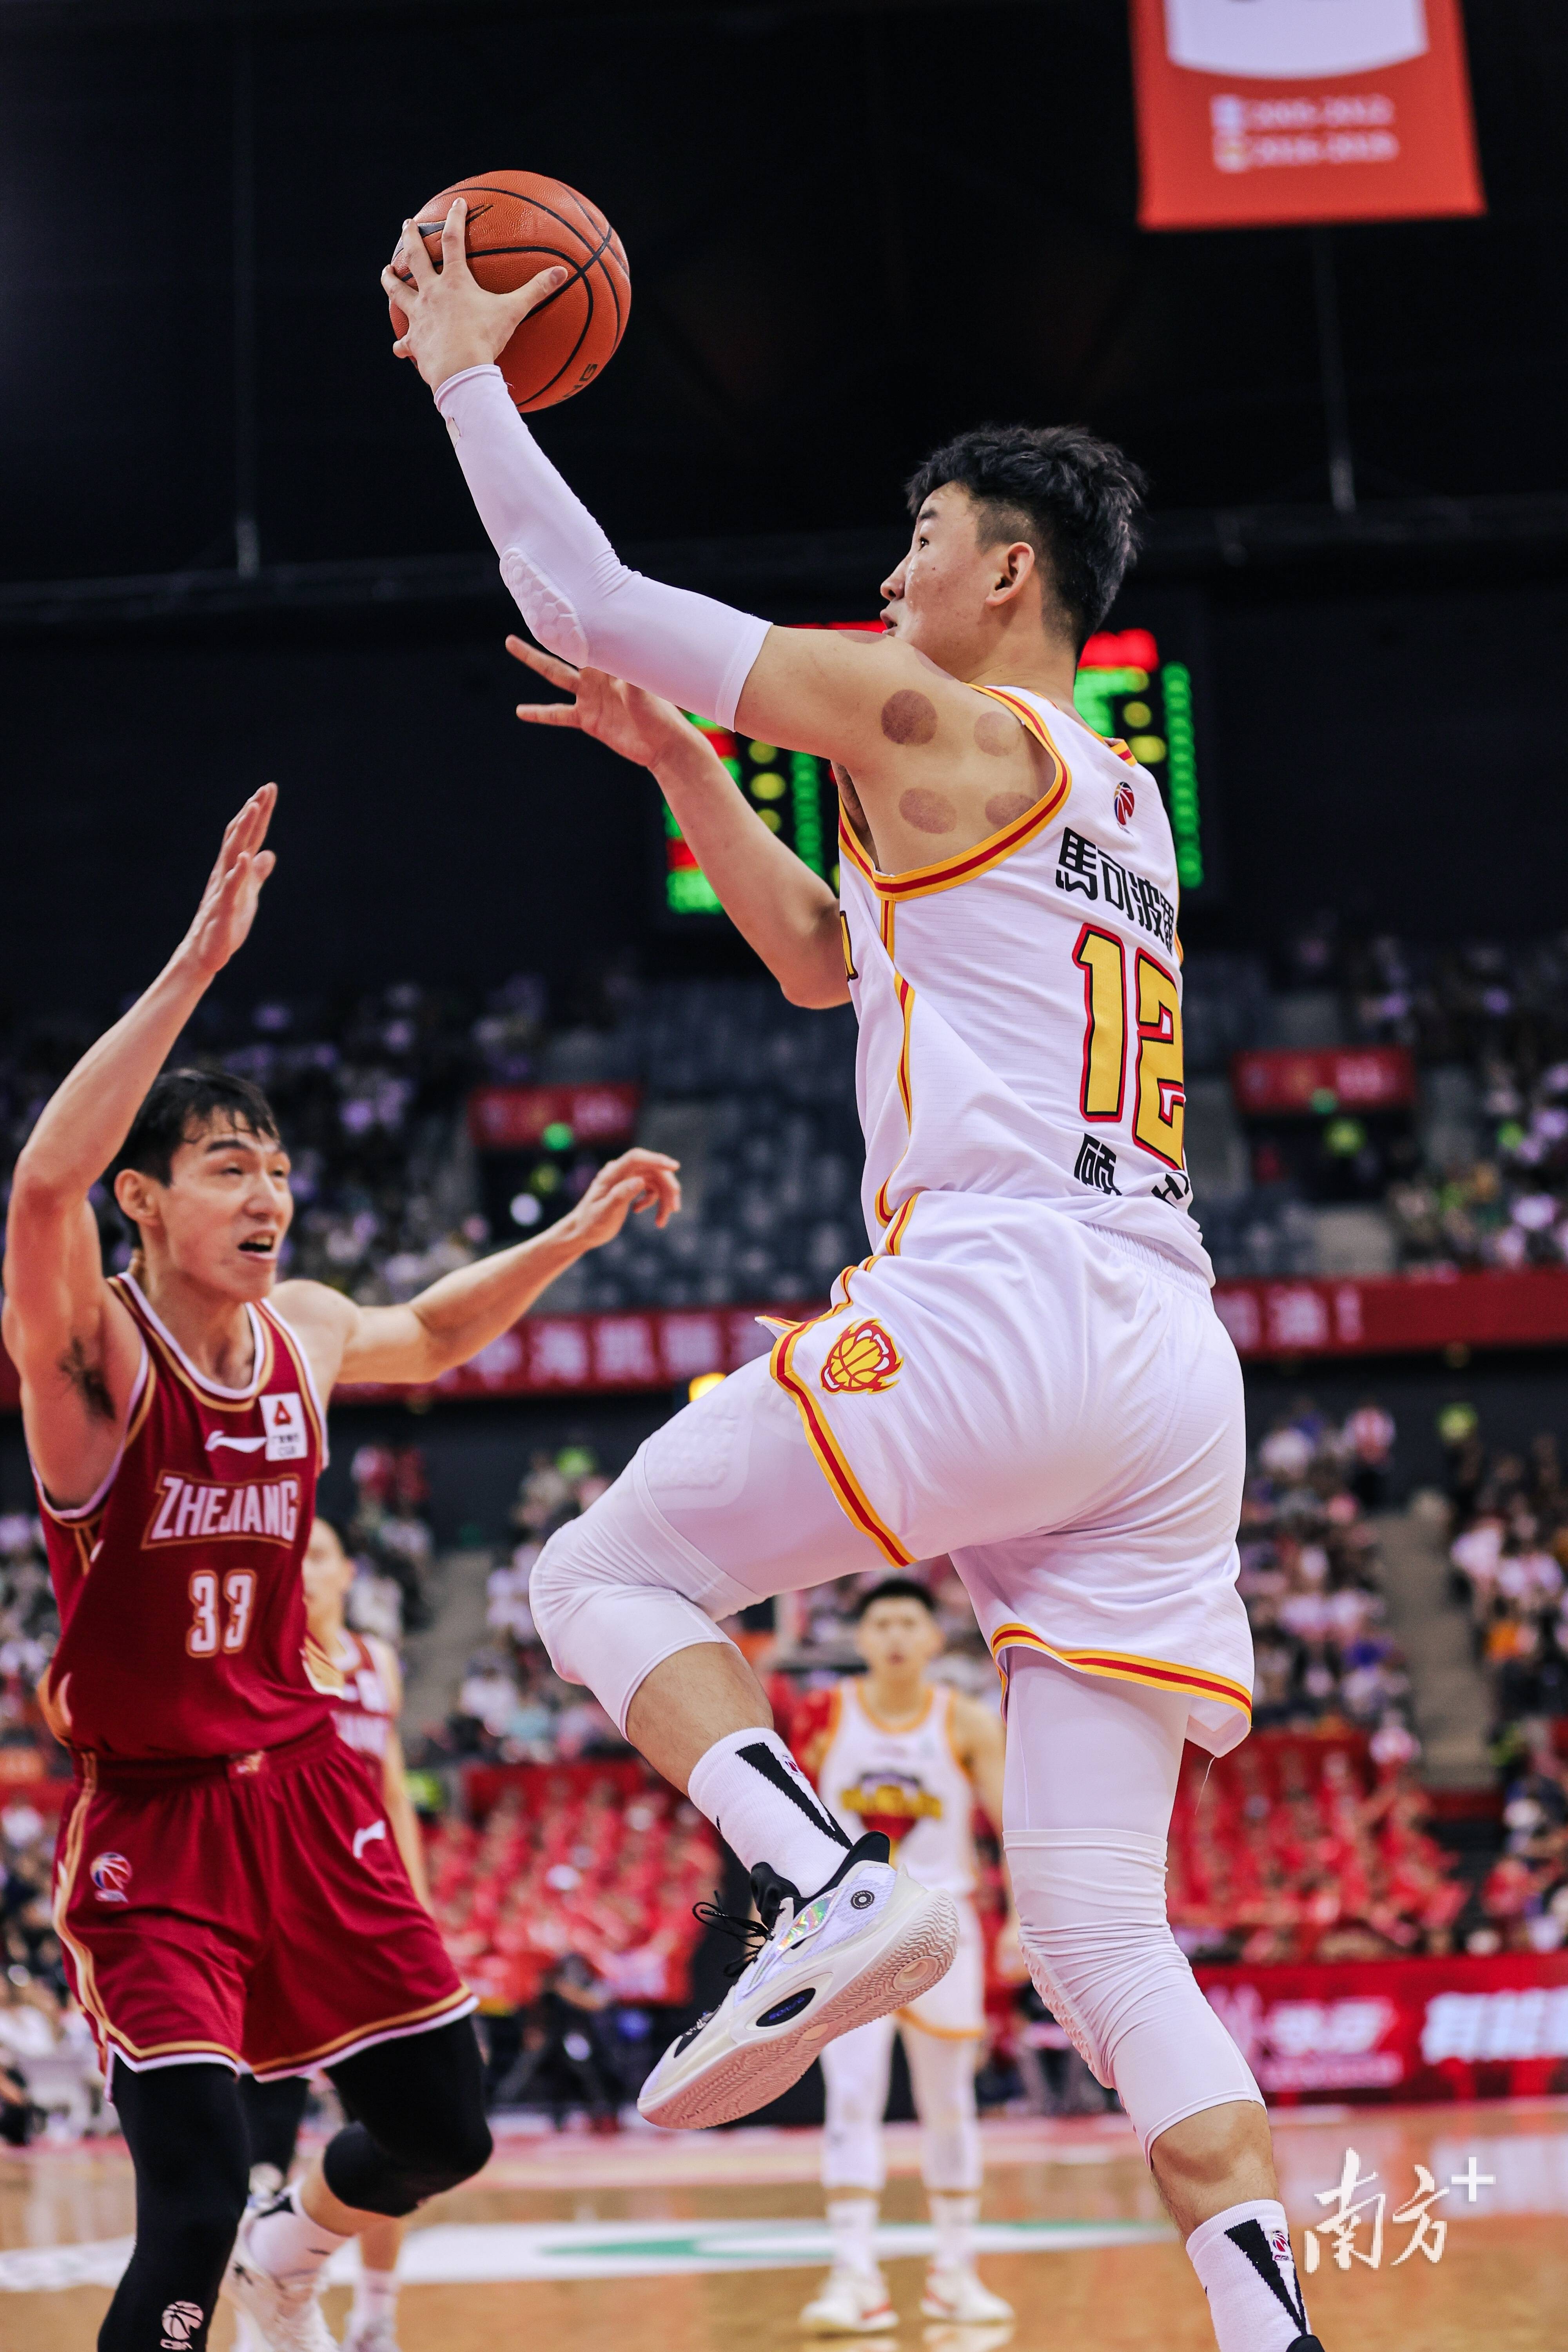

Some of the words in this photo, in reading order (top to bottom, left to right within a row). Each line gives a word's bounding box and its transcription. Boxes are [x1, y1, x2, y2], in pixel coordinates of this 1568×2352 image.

[1072, 922, 1185, 1171] 12
[146, 1473, 300, 1546] ZHEJIANG
[187, 1571, 256, 1656] 33
